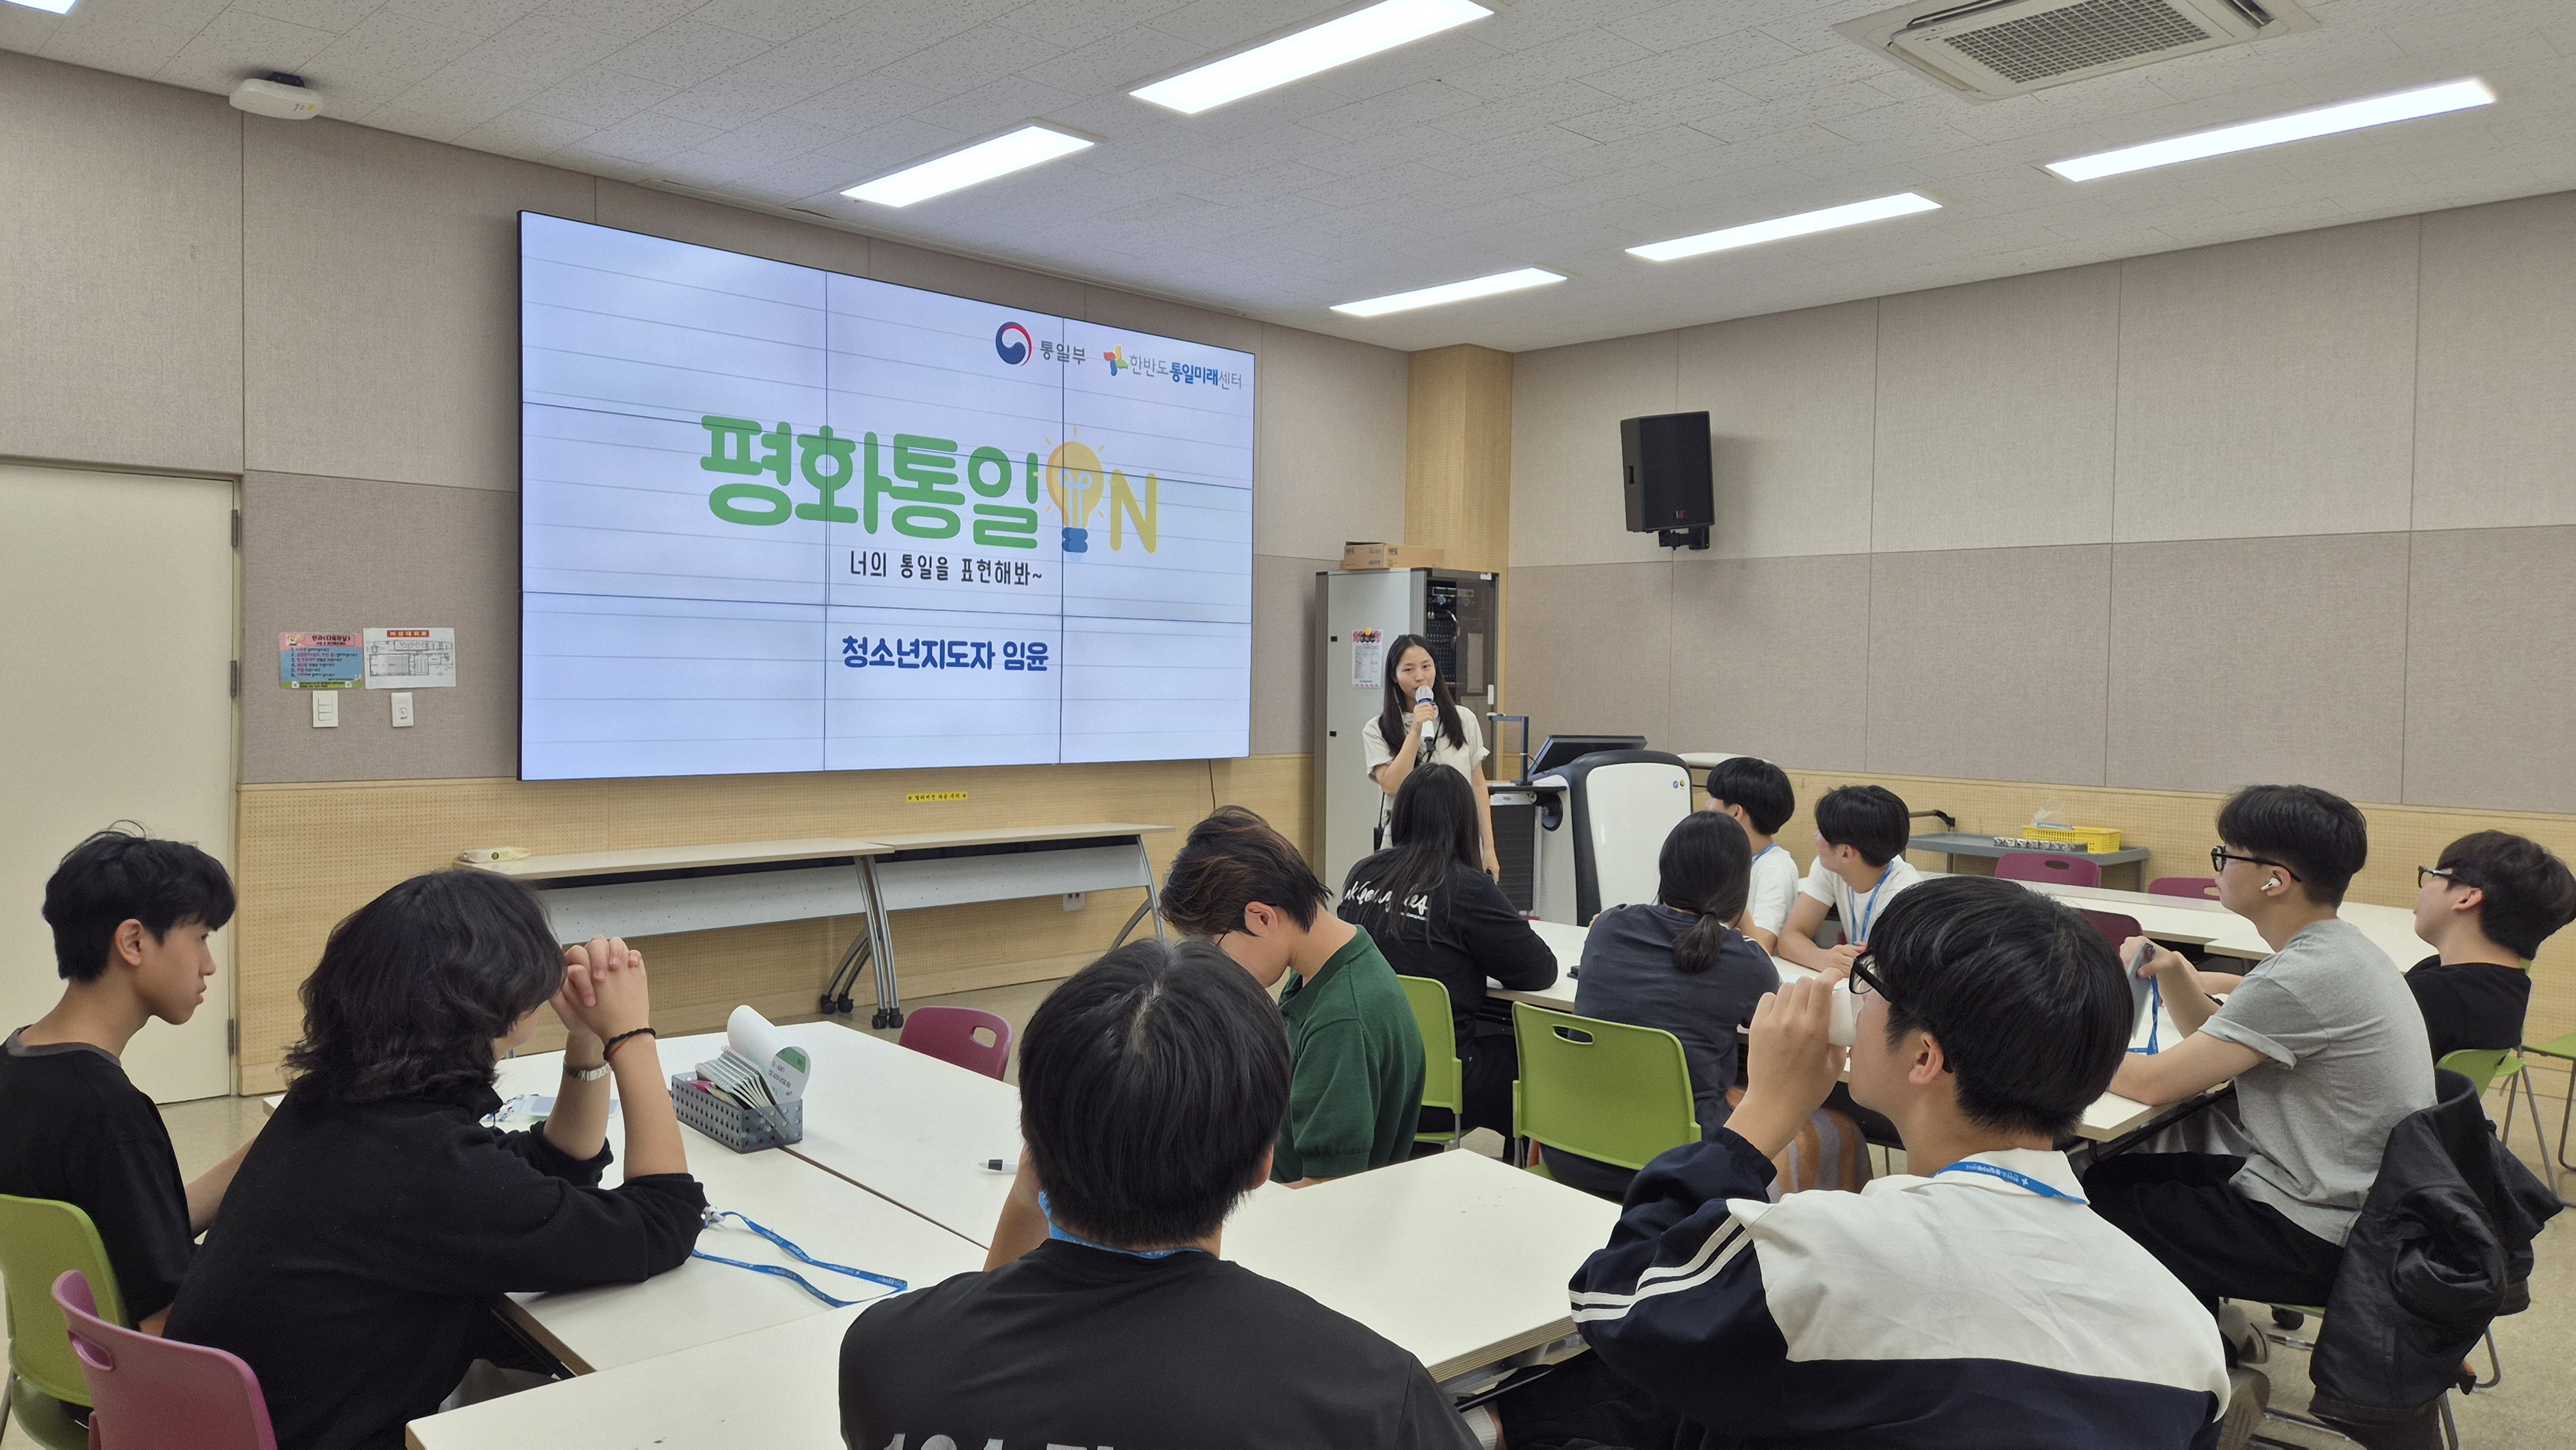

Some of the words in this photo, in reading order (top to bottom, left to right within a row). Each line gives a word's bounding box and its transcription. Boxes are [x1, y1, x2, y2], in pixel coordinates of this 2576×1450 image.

[1040, 340, 1086, 365] 통일부
[1130, 353, 1242, 390] 한반도통일미래센터
[700, 415, 1038, 549] 평화통일
[850, 550, 886, 577] 너의
[900, 554, 949, 581] 통일을
[961, 558, 1042, 585] 표현해봐~
[842, 635, 996, 670] 청소년지도자
[1003, 641, 1049, 671] 임윤
